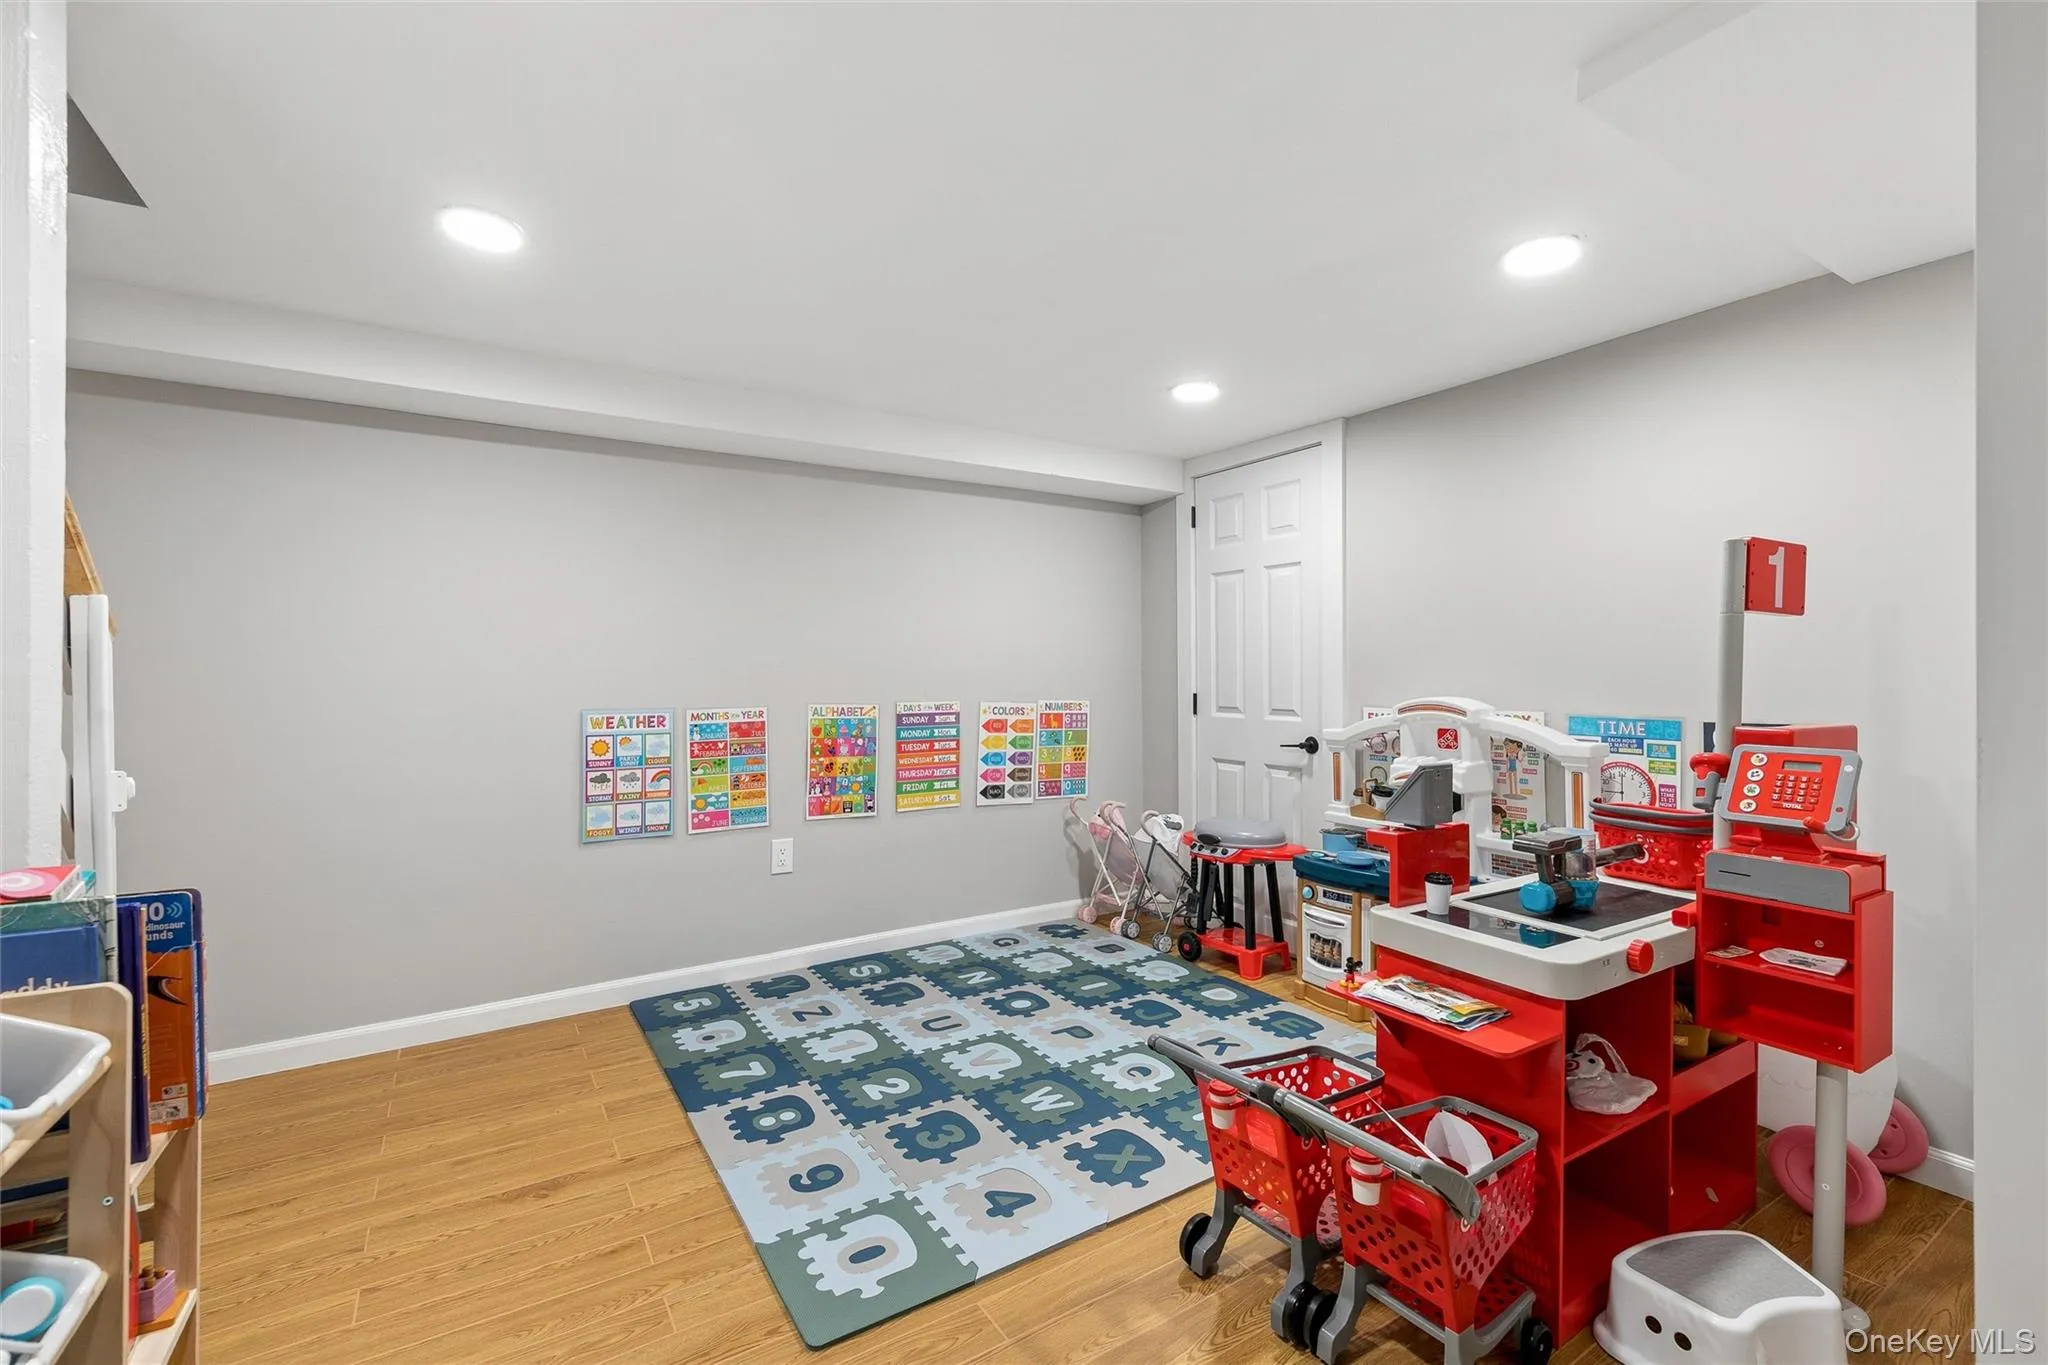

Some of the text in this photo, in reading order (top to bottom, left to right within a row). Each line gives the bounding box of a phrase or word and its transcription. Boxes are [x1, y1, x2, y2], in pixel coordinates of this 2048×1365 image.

[1768, 546, 1784, 608] 1
[812, 706, 865, 717] ALPHABET
[903, 704, 921, 712] DAYS
[933, 703, 954, 711] WEEK
[992, 706, 1026, 716] COLORS
[1044, 702, 1083, 711] NUMBERS
[690, 712, 729, 721] MONTHS
[741, 710, 764, 719] YEAR
[902, 716, 930, 724] SUNDAY
[1065, 714, 1071, 724] 6
[589, 715, 667, 730] WEATHER
[1598, 720, 1646, 736] TIME
[900, 729, 930, 738] MONDAY
[1040, 731, 1047, 741] 2
[1066, 731, 1073, 741] 7
[900, 743, 930, 751] TUESDAY
[588, 760, 612, 768] SUNNY
[898, 756, 934, 764] WEDNESDAY
[899, 769, 933, 778] THURSDAY
[1039, 765, 1046, 775] 4
[1064, 764, 1071, 774] 9
[902, 782, 928, 792] FRIDAY
[1039, 782, 1046, 792] 5
[146, 921, 185, 931] dinosaur
[992, 937, 1021, 947] G
[849, 964, 882, 978] S
[957, 971, 996, 985] N
[881, 986, 917, 998] T
[672, 997, 712, 1012] 5
[1133, 1008, 1175, 1021] J
[921, 1015, 962, 1032] U
[1271, 1017, 1316, 1034] E
[696, 1028, 736, 1044] 6
[1050, 1025, 1094, 1039] P
[828, 1038, 868, 1052] 1
[1196, 1036, 1241, 1056] K
[969, 1049, 1012, 1067] V
[719, 1061, 767, 1080] 7
[1118, 1062, 1161, 1084] Q
[861, 1077, 910, 1101] 2
[1020, 1086, 1075, 1112] W
[752, 1108, 802, 1132] 8
[916, 1124, 966, 1149] 3
[1092, 1143, 1153, 1175] X
[788, 1163, 844, 1193] 9
[984, 1189, 1037, 1219] 4
